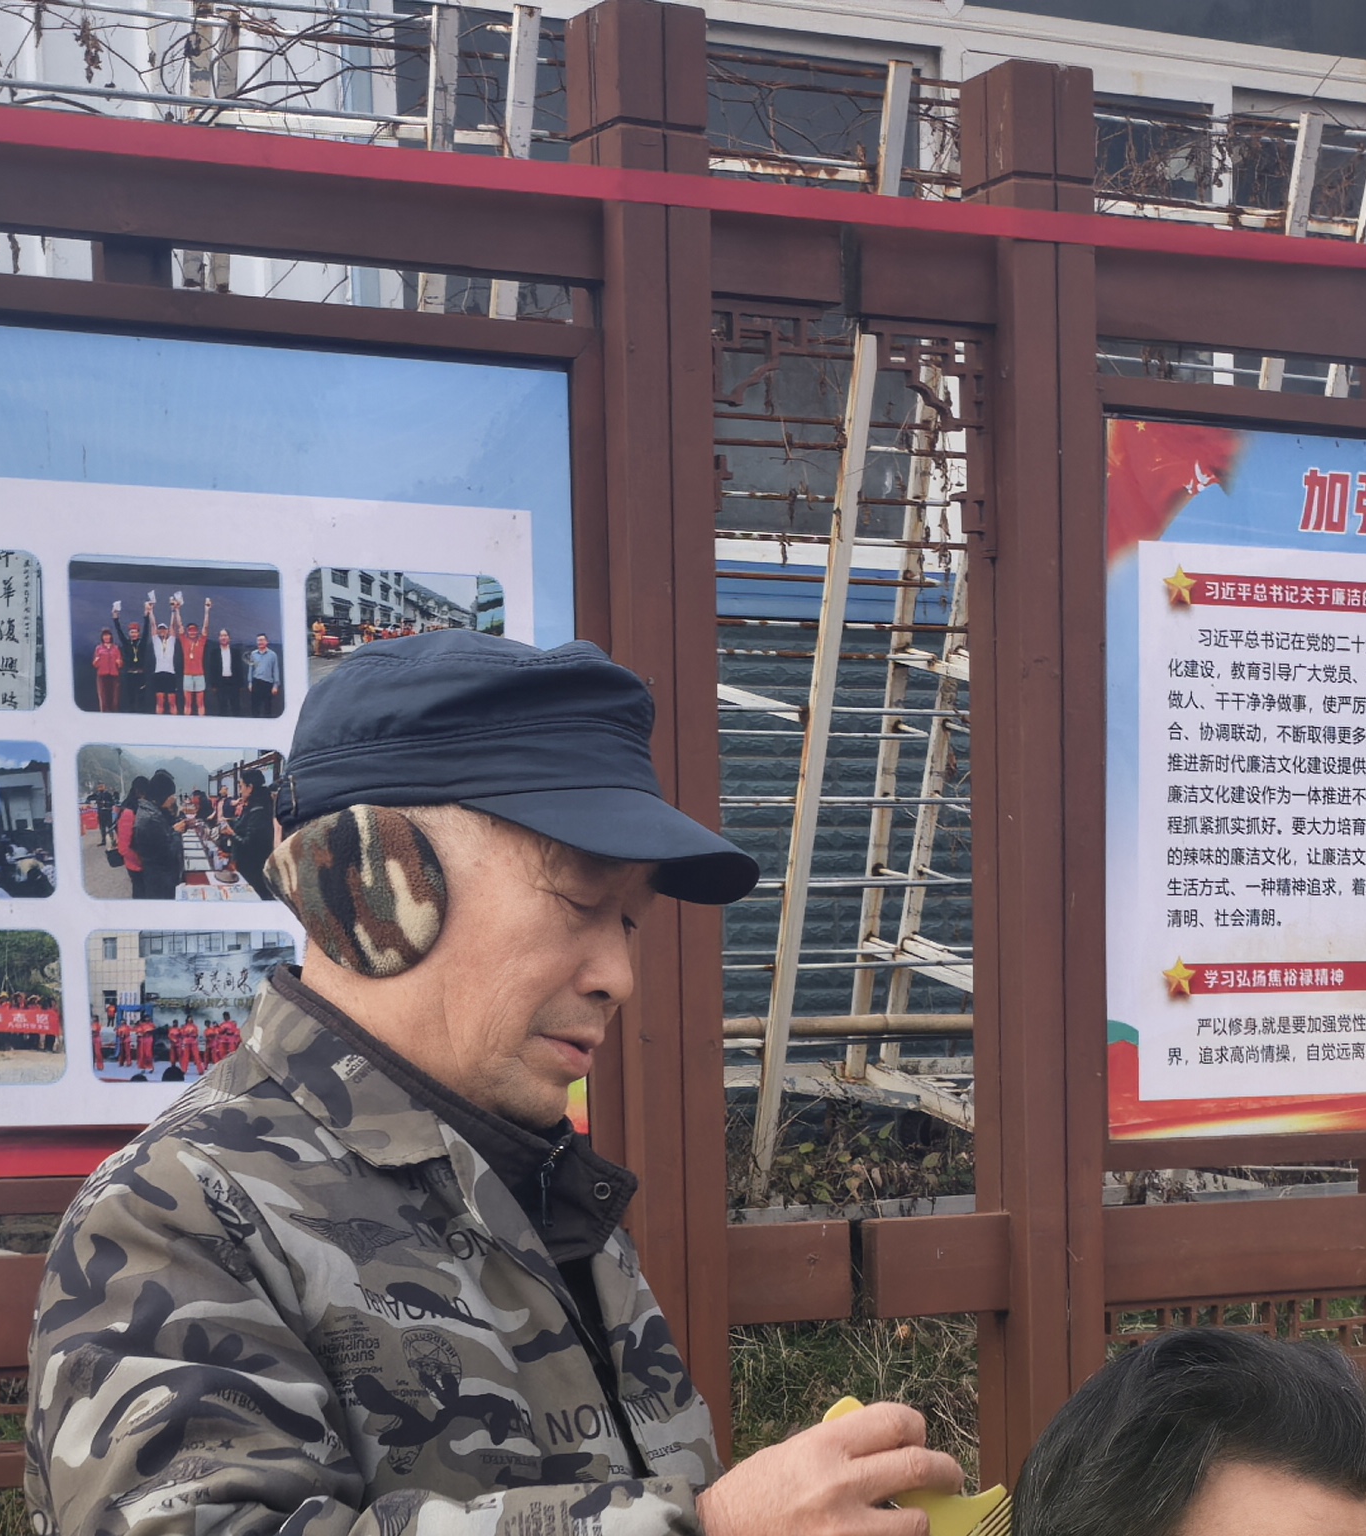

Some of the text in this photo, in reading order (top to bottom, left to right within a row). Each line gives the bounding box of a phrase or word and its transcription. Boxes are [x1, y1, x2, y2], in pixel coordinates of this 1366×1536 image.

[1166, 907, 1282, 929] 清明、社会清朗。
[1204, 967, 1345, 989] 学习弘扬焦裕禄精神
